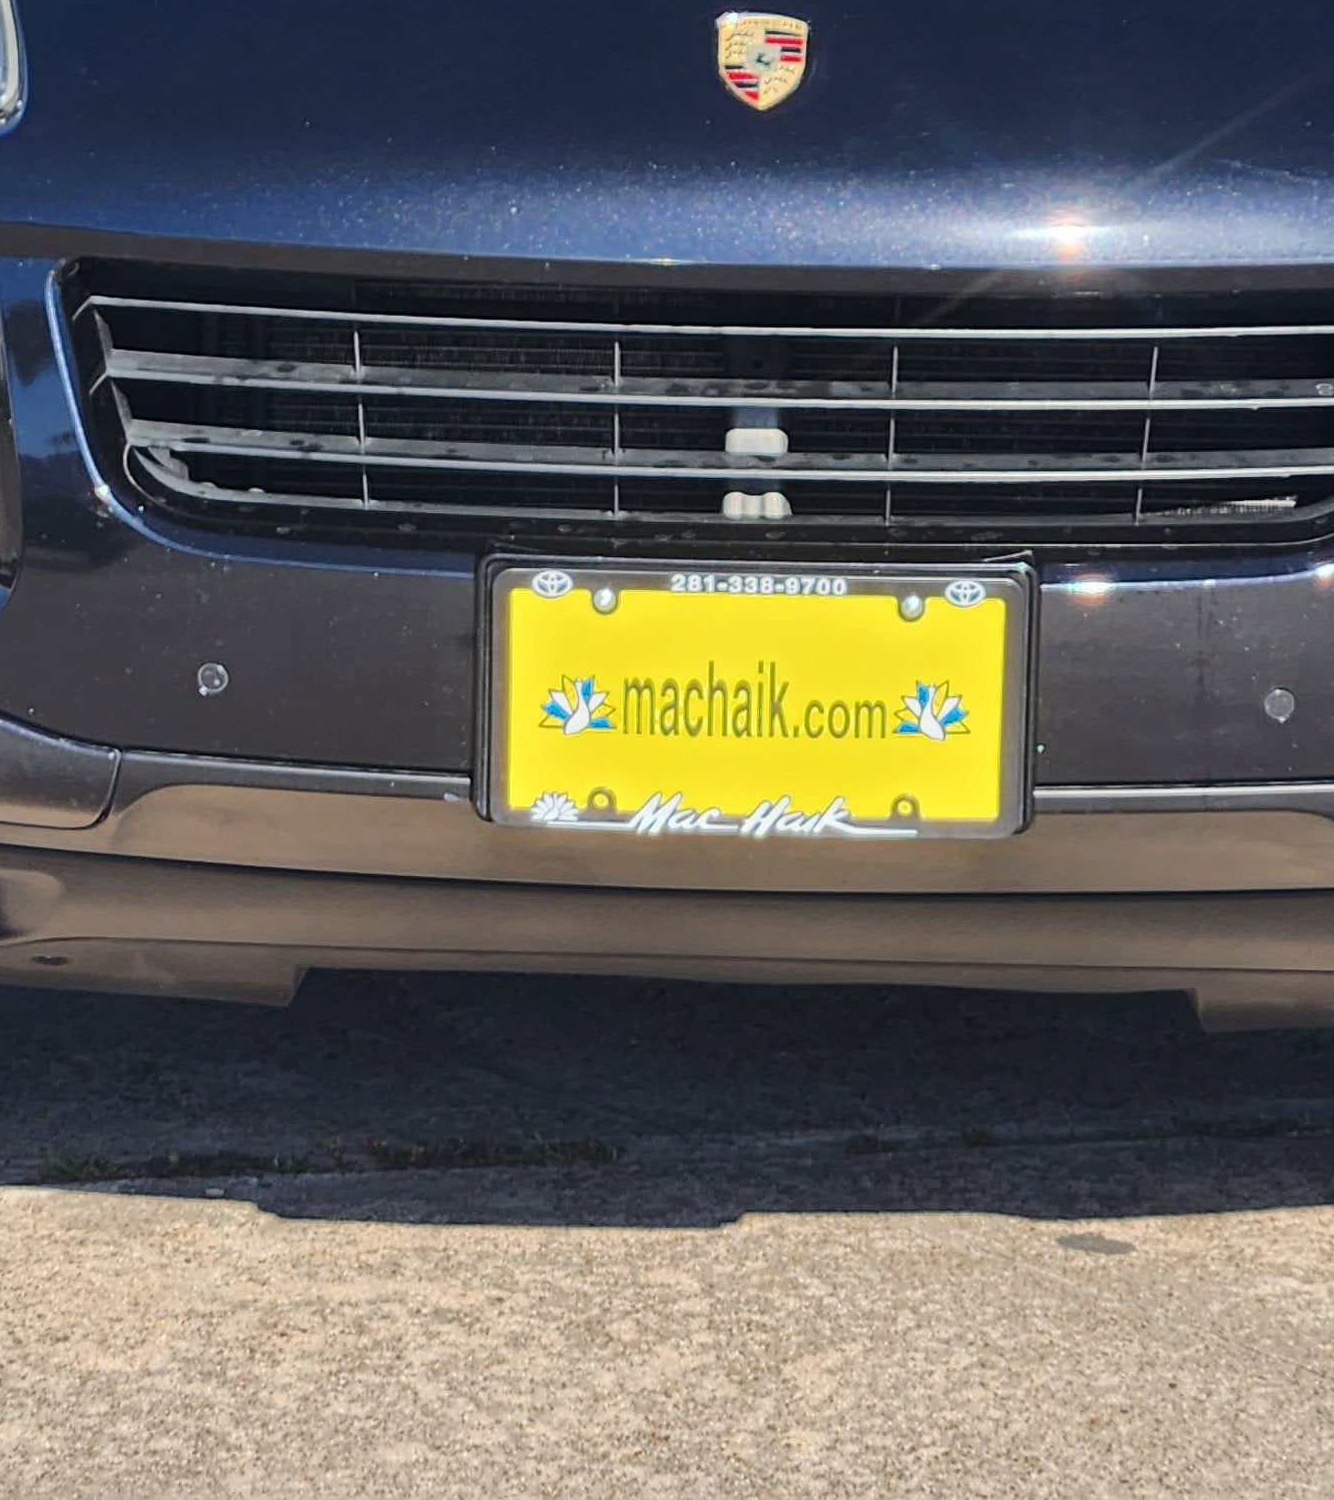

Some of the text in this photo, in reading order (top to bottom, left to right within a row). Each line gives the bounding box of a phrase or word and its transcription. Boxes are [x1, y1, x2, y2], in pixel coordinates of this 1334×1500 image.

[670, 573, 848, 596] 281-338-9700
[621, 660, 888, 739] machaik.com
[628, 792, 882, 838] Mac Haik
